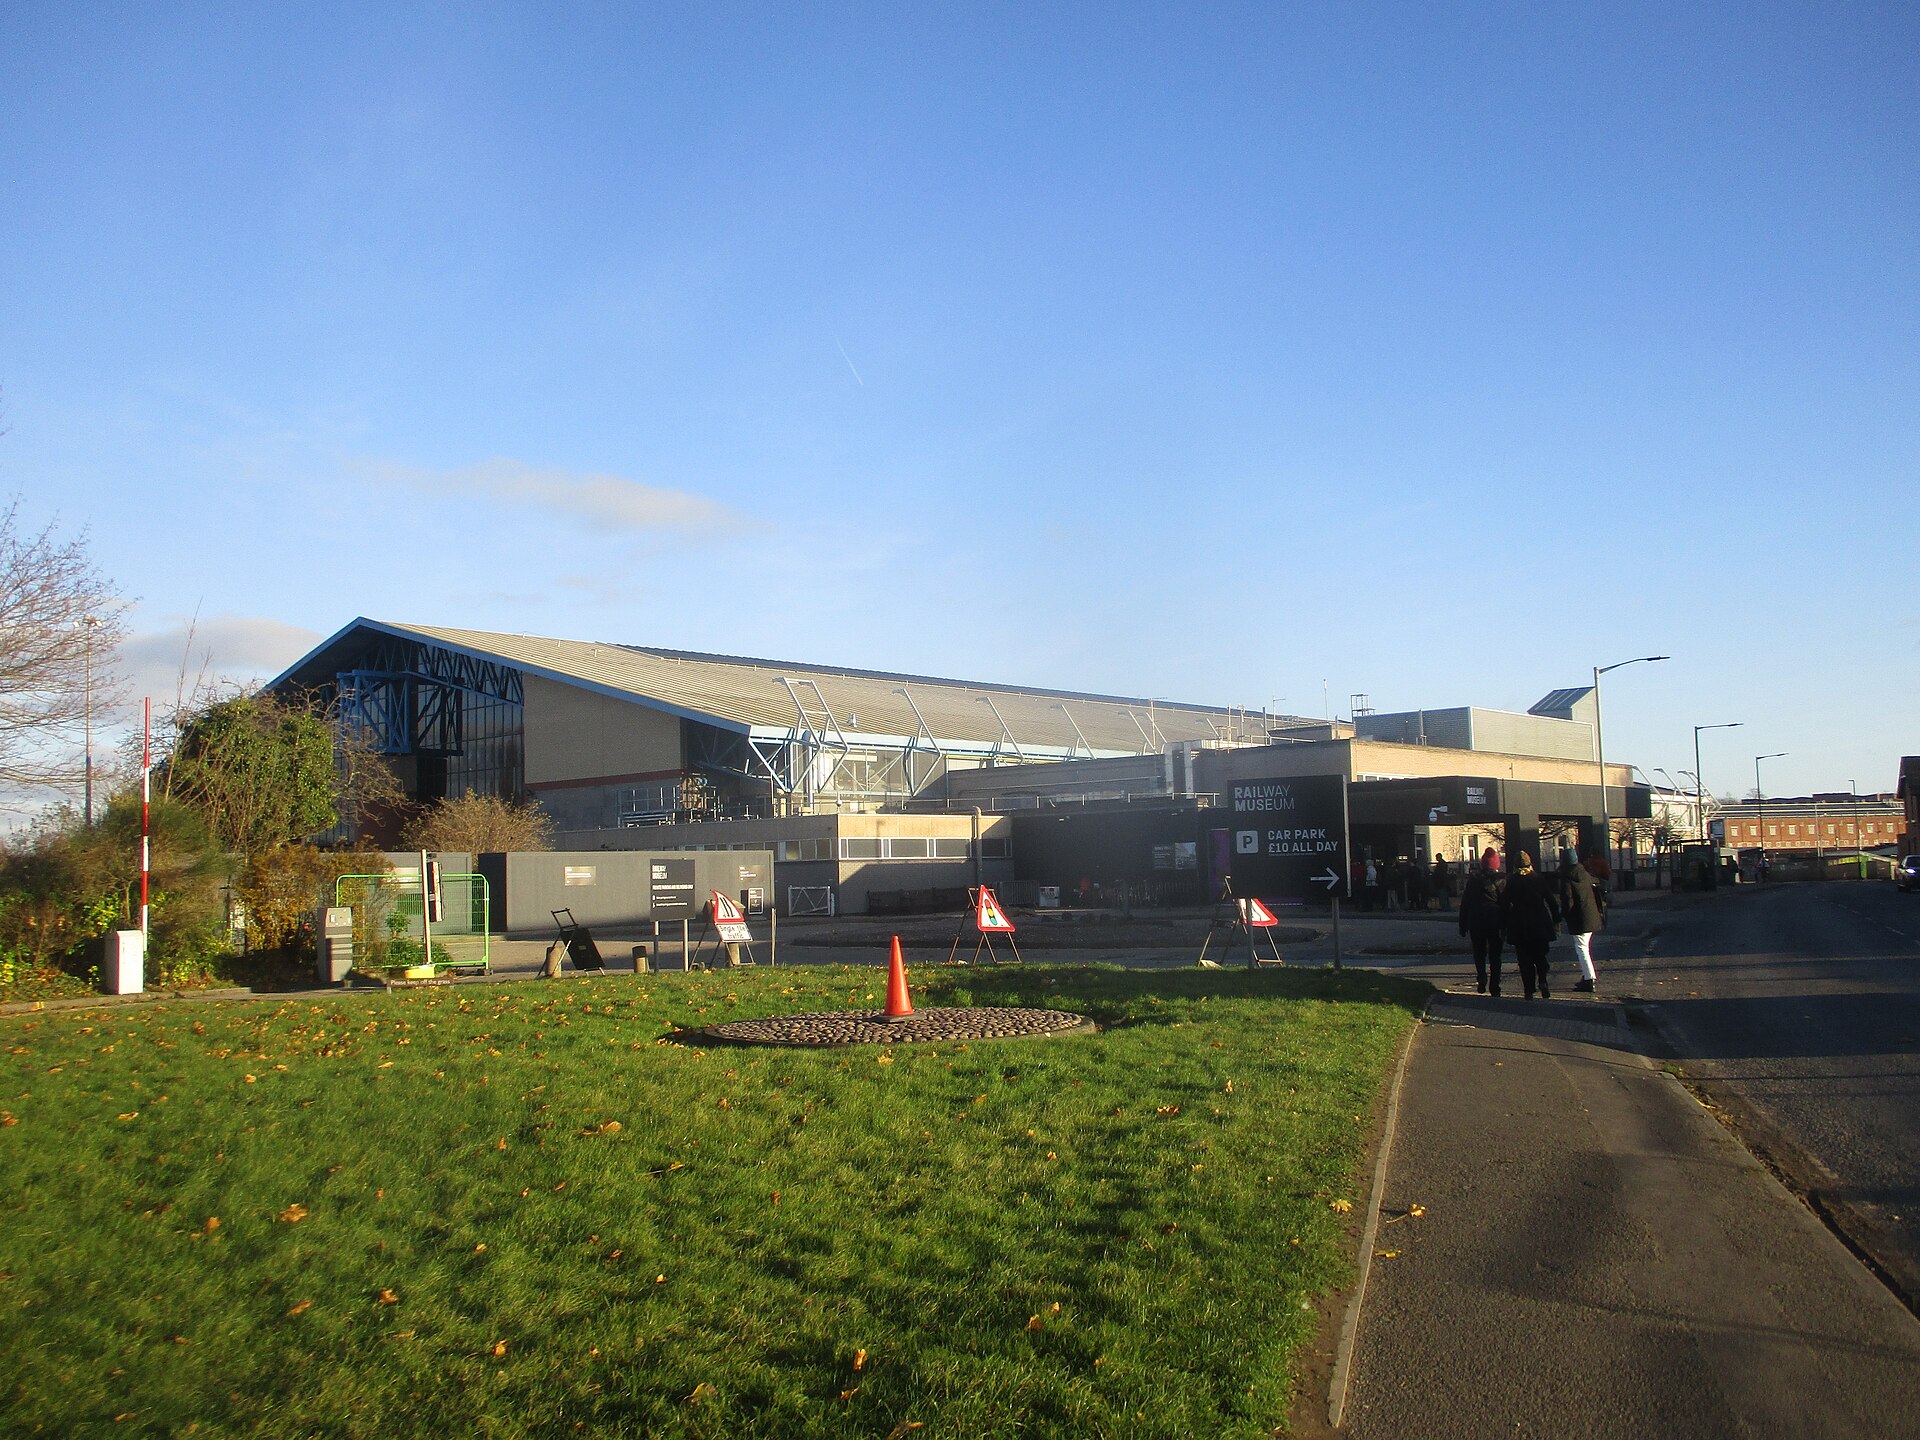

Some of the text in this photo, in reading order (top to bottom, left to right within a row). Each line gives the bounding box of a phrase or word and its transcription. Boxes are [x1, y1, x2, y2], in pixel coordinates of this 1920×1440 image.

[1234, 784, 1291, 799] RAILWAY
[1235, 797, 1295, 812] MUSEUM
[1267, 828, 1326, 840] CAR PARK
[1243, 835, 1253, 849] P
[1268, 841, 1338, 853] £10 ALL DAY
